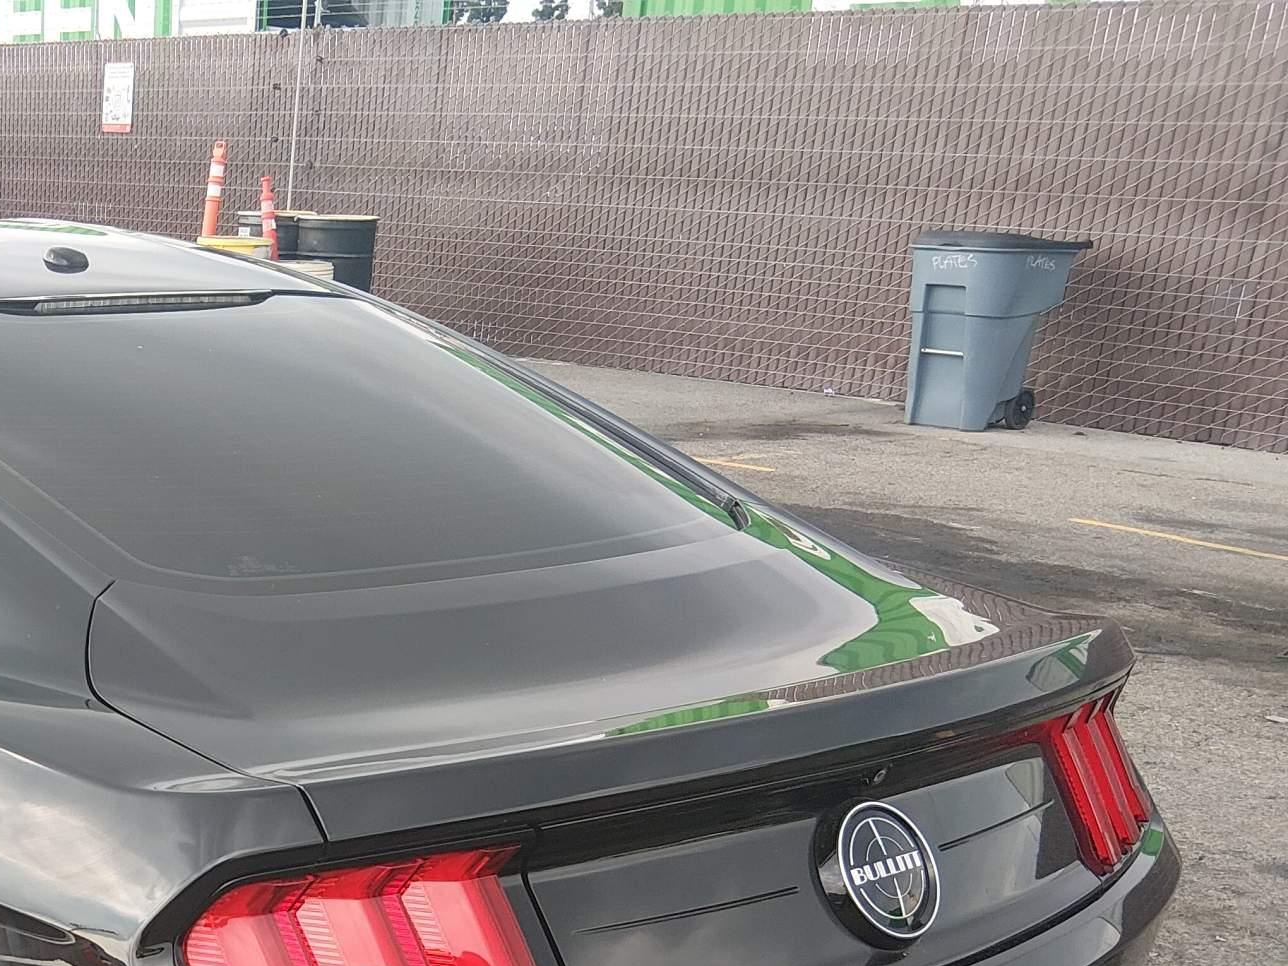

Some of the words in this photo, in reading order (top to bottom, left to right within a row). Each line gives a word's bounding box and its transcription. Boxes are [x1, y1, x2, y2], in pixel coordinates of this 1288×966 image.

[931, 254, 978, 272] PLATES
[1027, 255, 1056, 273] PLATES
[850, 850, 923, 886] BULLITT
